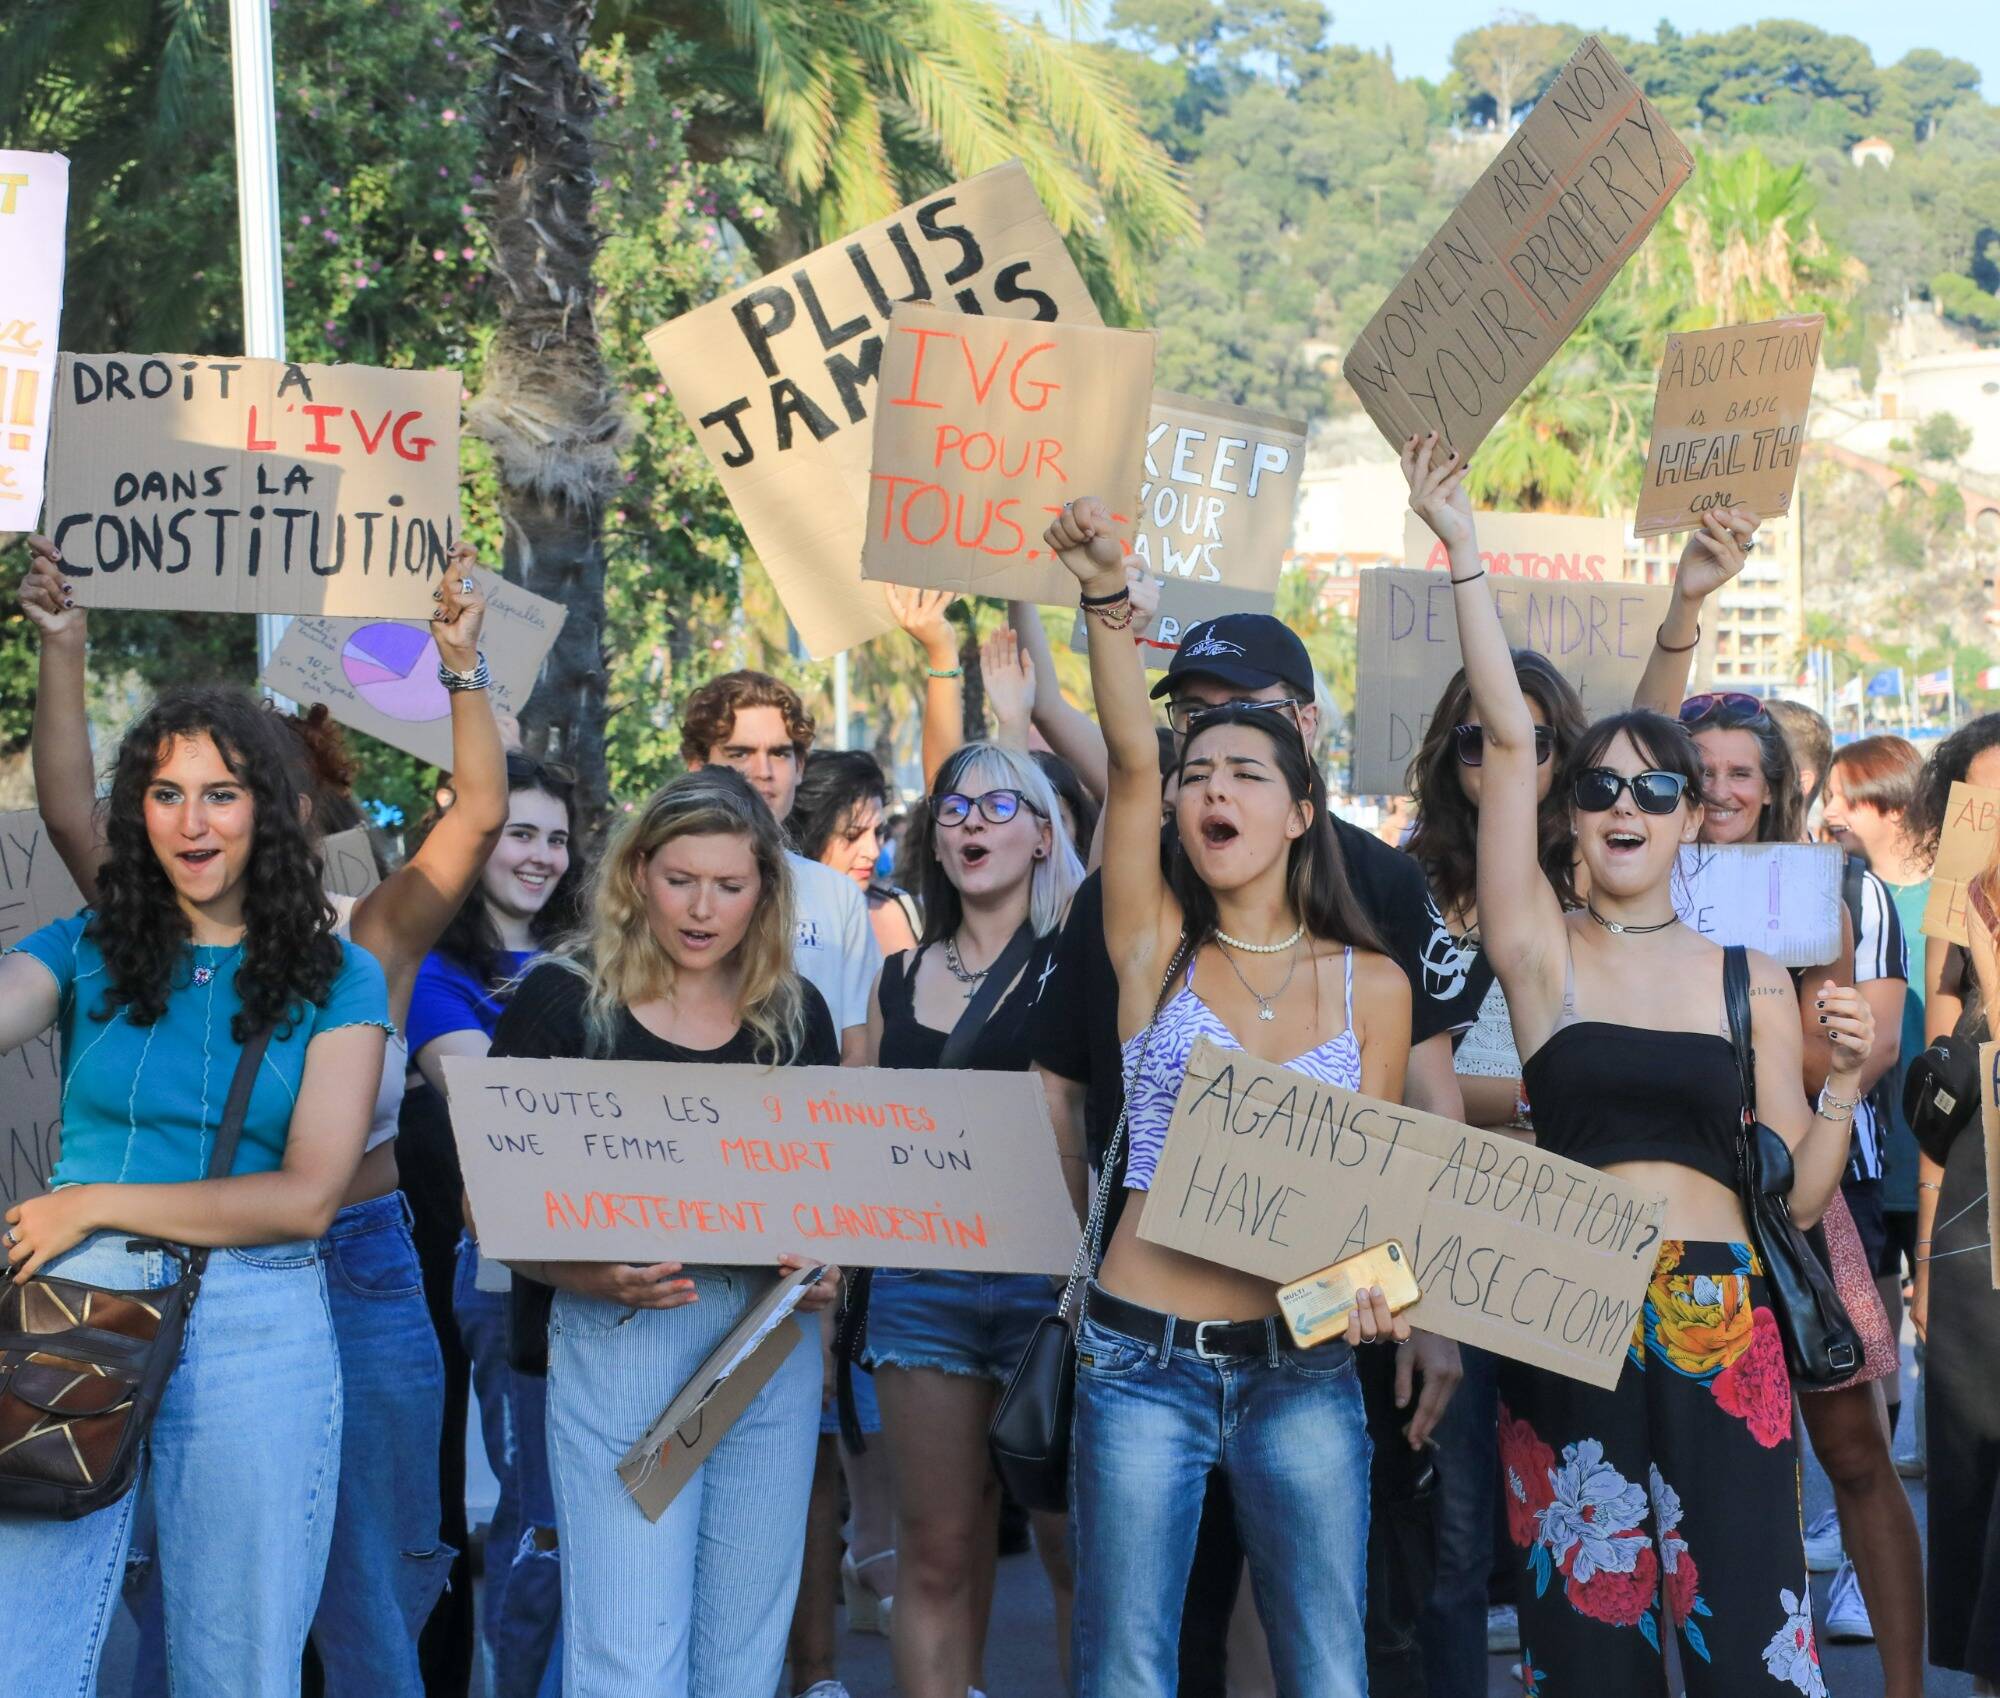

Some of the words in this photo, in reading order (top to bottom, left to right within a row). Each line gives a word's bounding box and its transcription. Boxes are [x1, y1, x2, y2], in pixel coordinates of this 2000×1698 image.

[1353, 226, 1482, 392] WOMEN
[1493, 135, 1554, 224] ARE
[1552, 44, 1618, 139] NOT
[731, 197, 984, 378] PLUS
[1409, 289, 1538, 446] YOUR
[1510, 98, 1666, 320] PROPERTY
[889, 327, 1061, 411] IVG
[1666, 328, 1823, 392] ABORTION
[246, 404, 437, 462] L'IVG
[1686, 408, 1706, 426] is
[1725, 396, 1779, 423] BASIC
[934, 424, 1068, 482] POUR
[1655, 424, 1800, 488] HEALTH
[114, 465, 229, 507] DANS
[257, 463, 314, 495] LA
[1689, 490, 1747, 513] care
[1133, 533, 1222, 583] AWS
[1391, 577, 1645, 659] DÉENDRE
[1750, 986, 1785, 997] alive
[485, 1085, 623, 1118] TOUTES
[663, 1094, 720, 1124] LES
[762, 1095, 783, 1124] 9
[487, 1133, 545, 1156] UNE
[583, 1134, 685, 1164] FEMME
[720, 1136, 837, 1172] MEURT
[1189, 1064, 1416, 1176] AGAINST
[1428, 1137, 1658, 1260] ABORTION?
[544, 1189, 767, 1234] AVORTEMENT
[1179, 1155, 1306, 1247] HAVE
[1333, 1204, 1368, 1263] A
[1413, 1224, 1640, 1356] VASECTOMY
